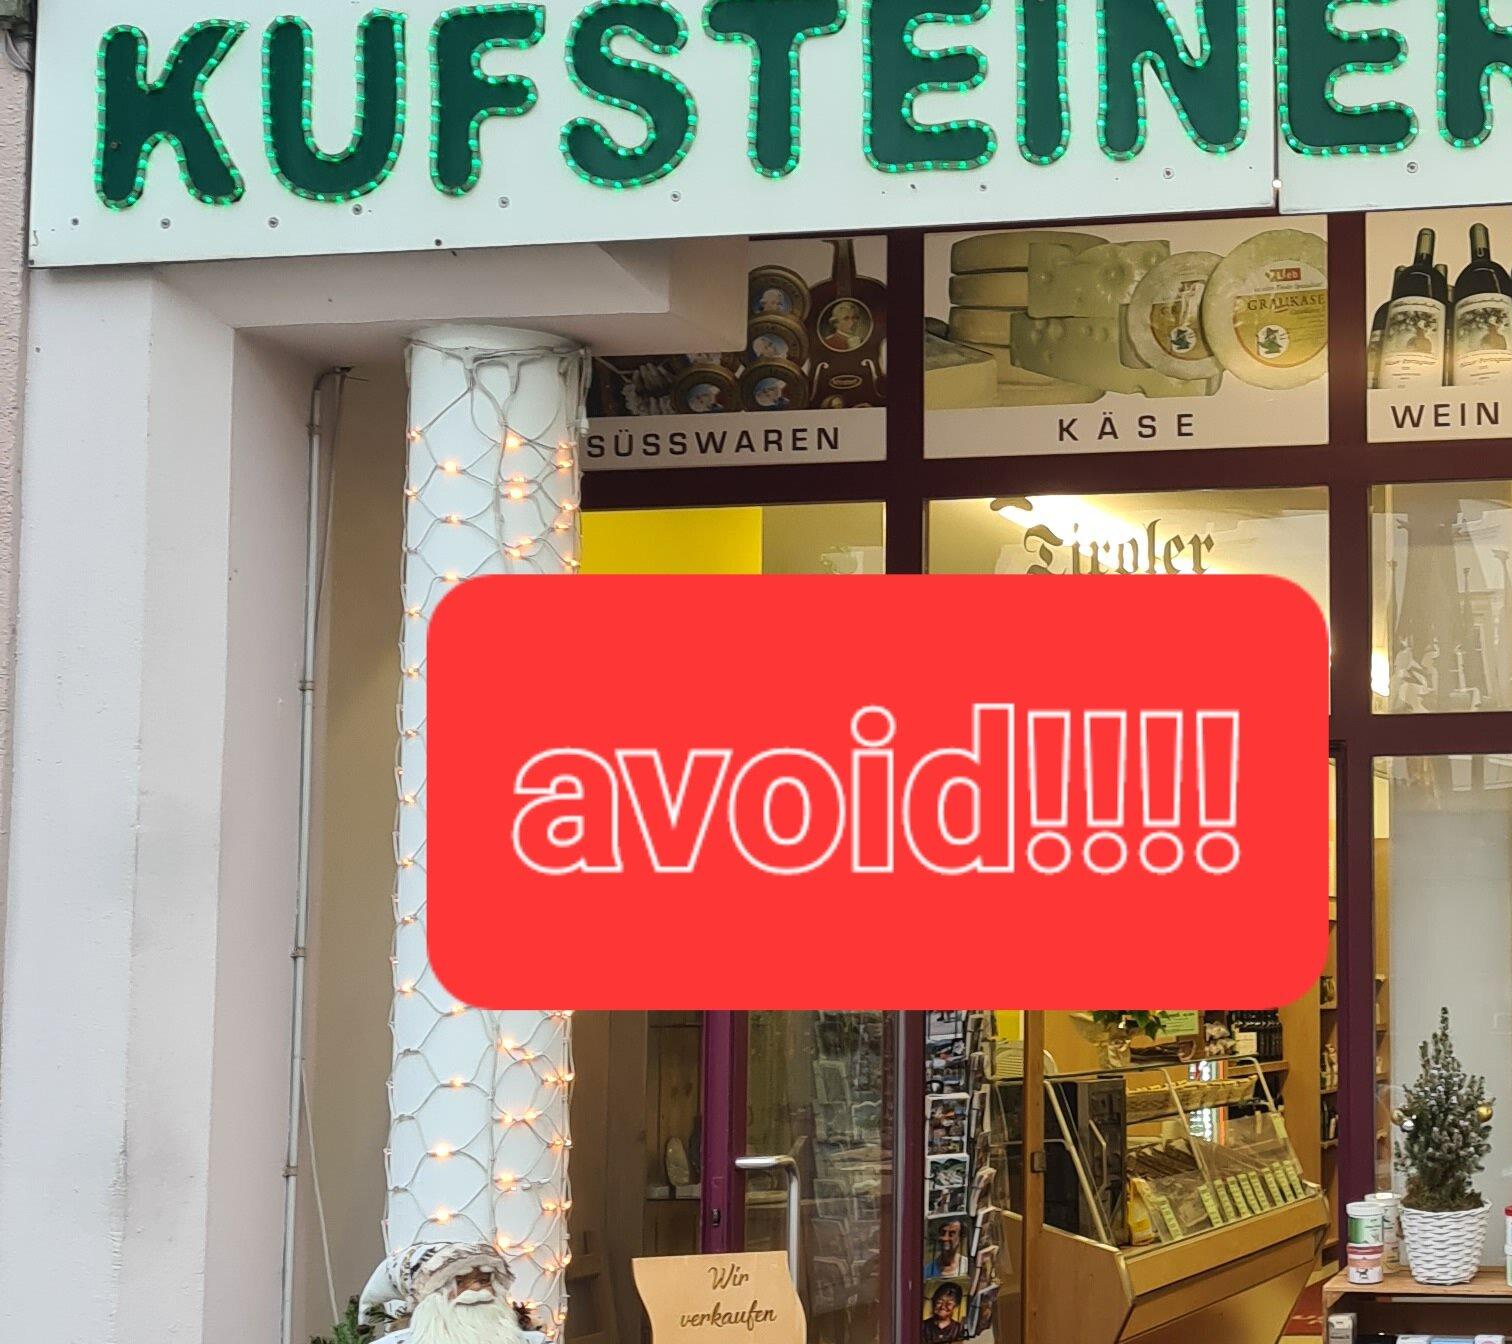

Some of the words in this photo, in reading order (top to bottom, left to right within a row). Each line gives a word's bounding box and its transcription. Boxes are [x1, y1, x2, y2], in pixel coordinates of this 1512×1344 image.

[1057, 412, 1197, 442] KÄSE
[1391, 400, 1500, 429] WEIN
[586, 425, 842, 458] SÜSSWAREN
[1023, 518, 1215, 574] Tiroler
[707, 1263, 749, 1291] Wir
[680, 1299, 777, 1331] verkaufen
